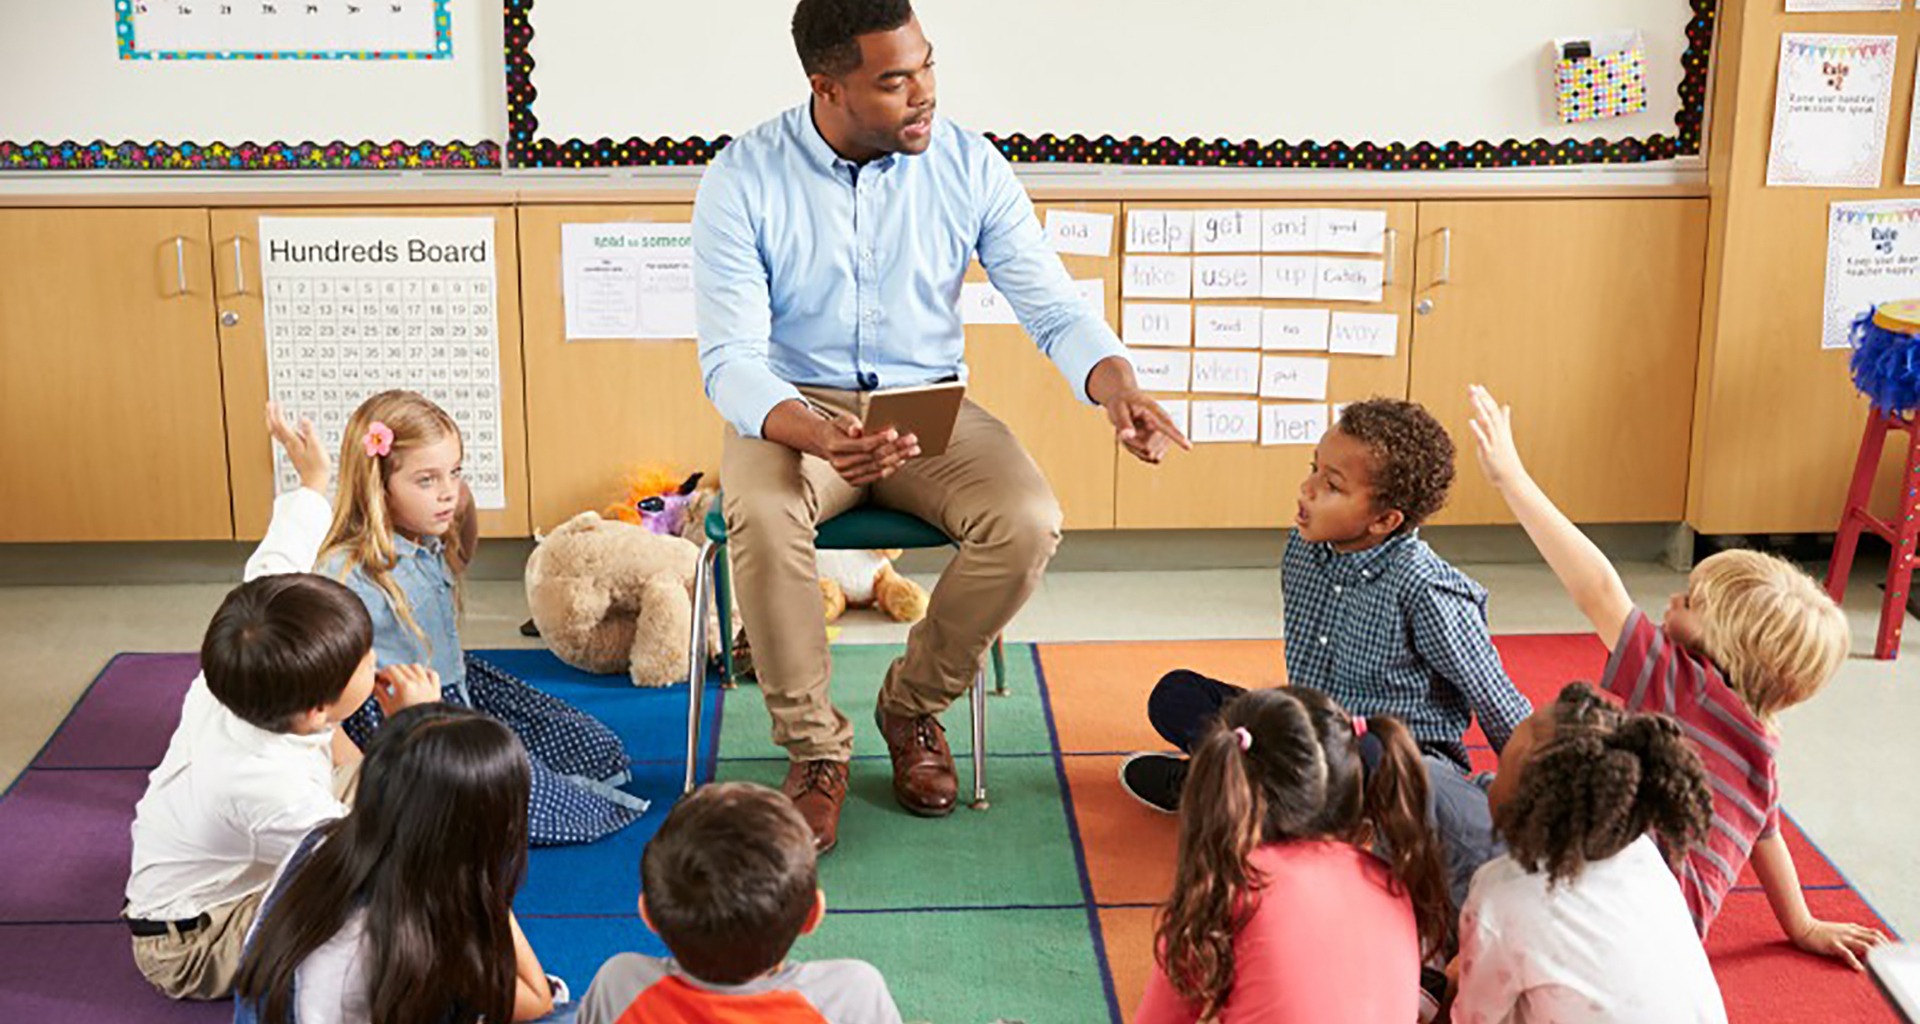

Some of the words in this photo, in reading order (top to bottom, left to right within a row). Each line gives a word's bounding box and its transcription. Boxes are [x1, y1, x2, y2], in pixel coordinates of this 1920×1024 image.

[1823, 61, 1850, 76] Rule
[1131, 213, 1182, 251] help
[1204, 212, 1243, 242] get
[1272, 216, 1307, 236] and
[1872, 227, 1898, 240] Rule
[269, 239, 399, 263] Hundreds
[407, 239, 486, 263] Board
[1132, 264, 1175, 285] take
[1202, 269, 1248, 287] use
[1276, 268, 1307, 288] up
[473, 283, 485, 293] 10
[275, 304, 287, 315] 11
[297, 304, 310, 315] 12
[319, 304, 333, 315] 13
[342, 304, 354, 315] 14
[364, 304, 377, 315] 15
[385, 304, 399, 315] 16
[407, 304, 421, 315] 17
[430, 304, 444, 315] 18
[453, 304, 466, 315] 19
[473, 304, 488, 315] 20
[1141, 314, 1169, 333] on
[1195, 359, 1249, 382] when
[1205, 404, 1245, 435] too
[1272, 409, 1317, 439] her
